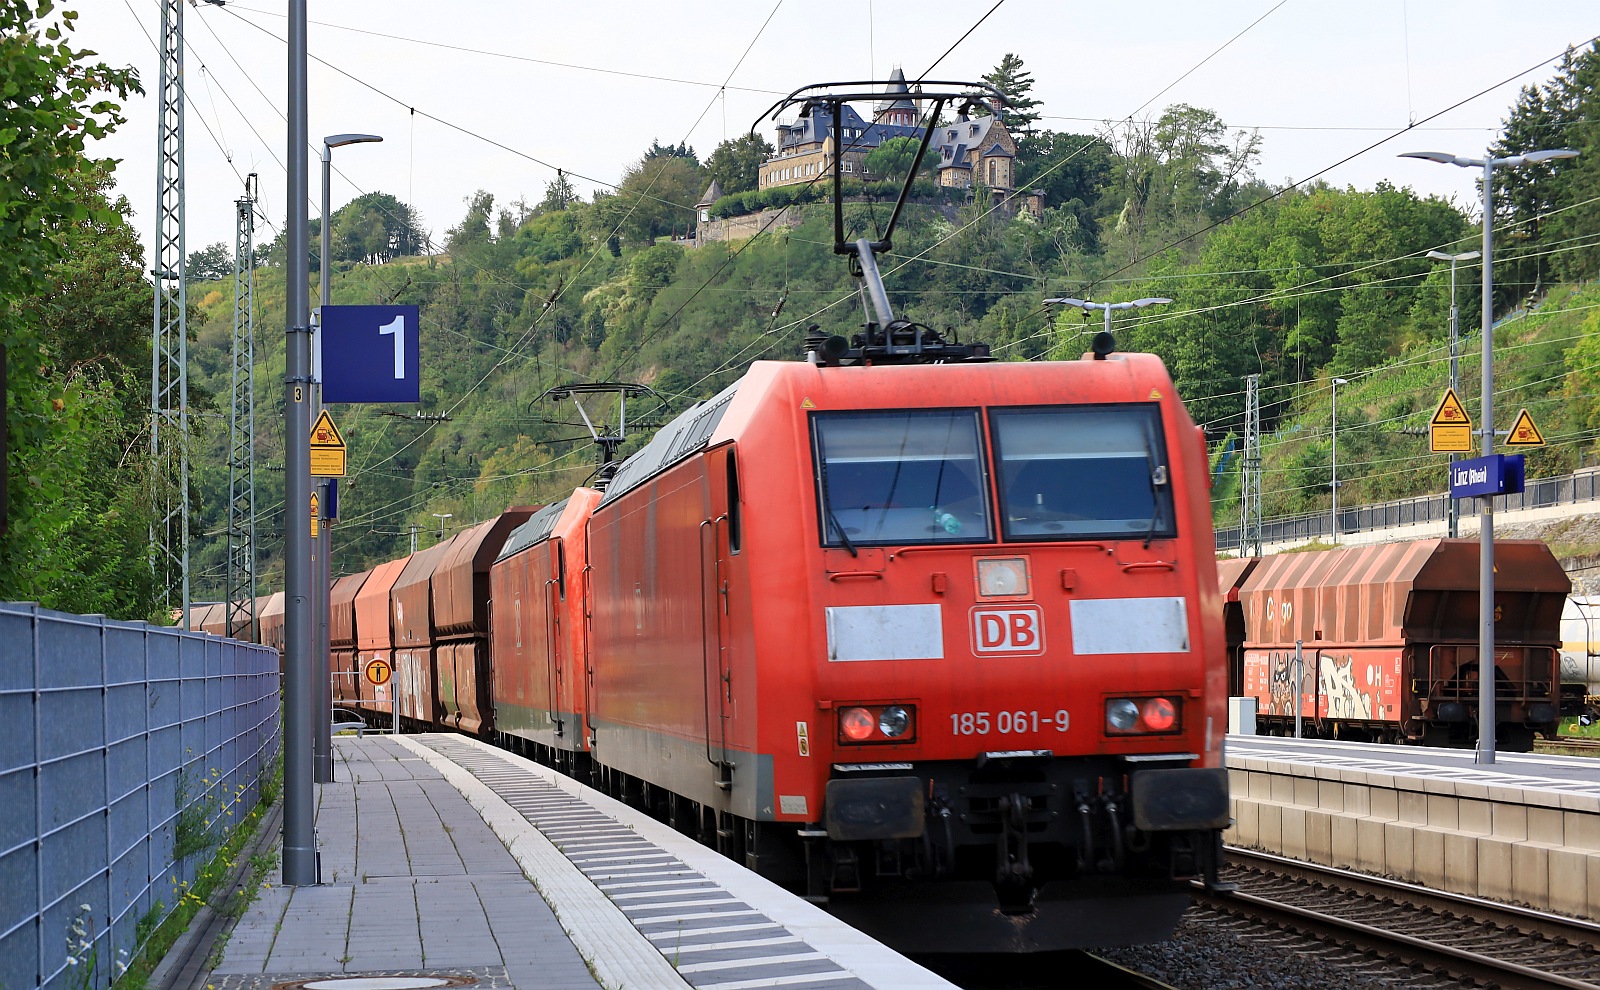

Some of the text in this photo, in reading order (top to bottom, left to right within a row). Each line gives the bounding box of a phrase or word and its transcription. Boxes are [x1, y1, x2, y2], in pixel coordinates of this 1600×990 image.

[379, 315, 405, 379] 1
[295, 388, 302, 401] 3
[1454, 465, 1487, 487] Linz (Rhein)
[979, 613, 1036, 649] DB
[950, 709, 1070, 735] 185 061-9
